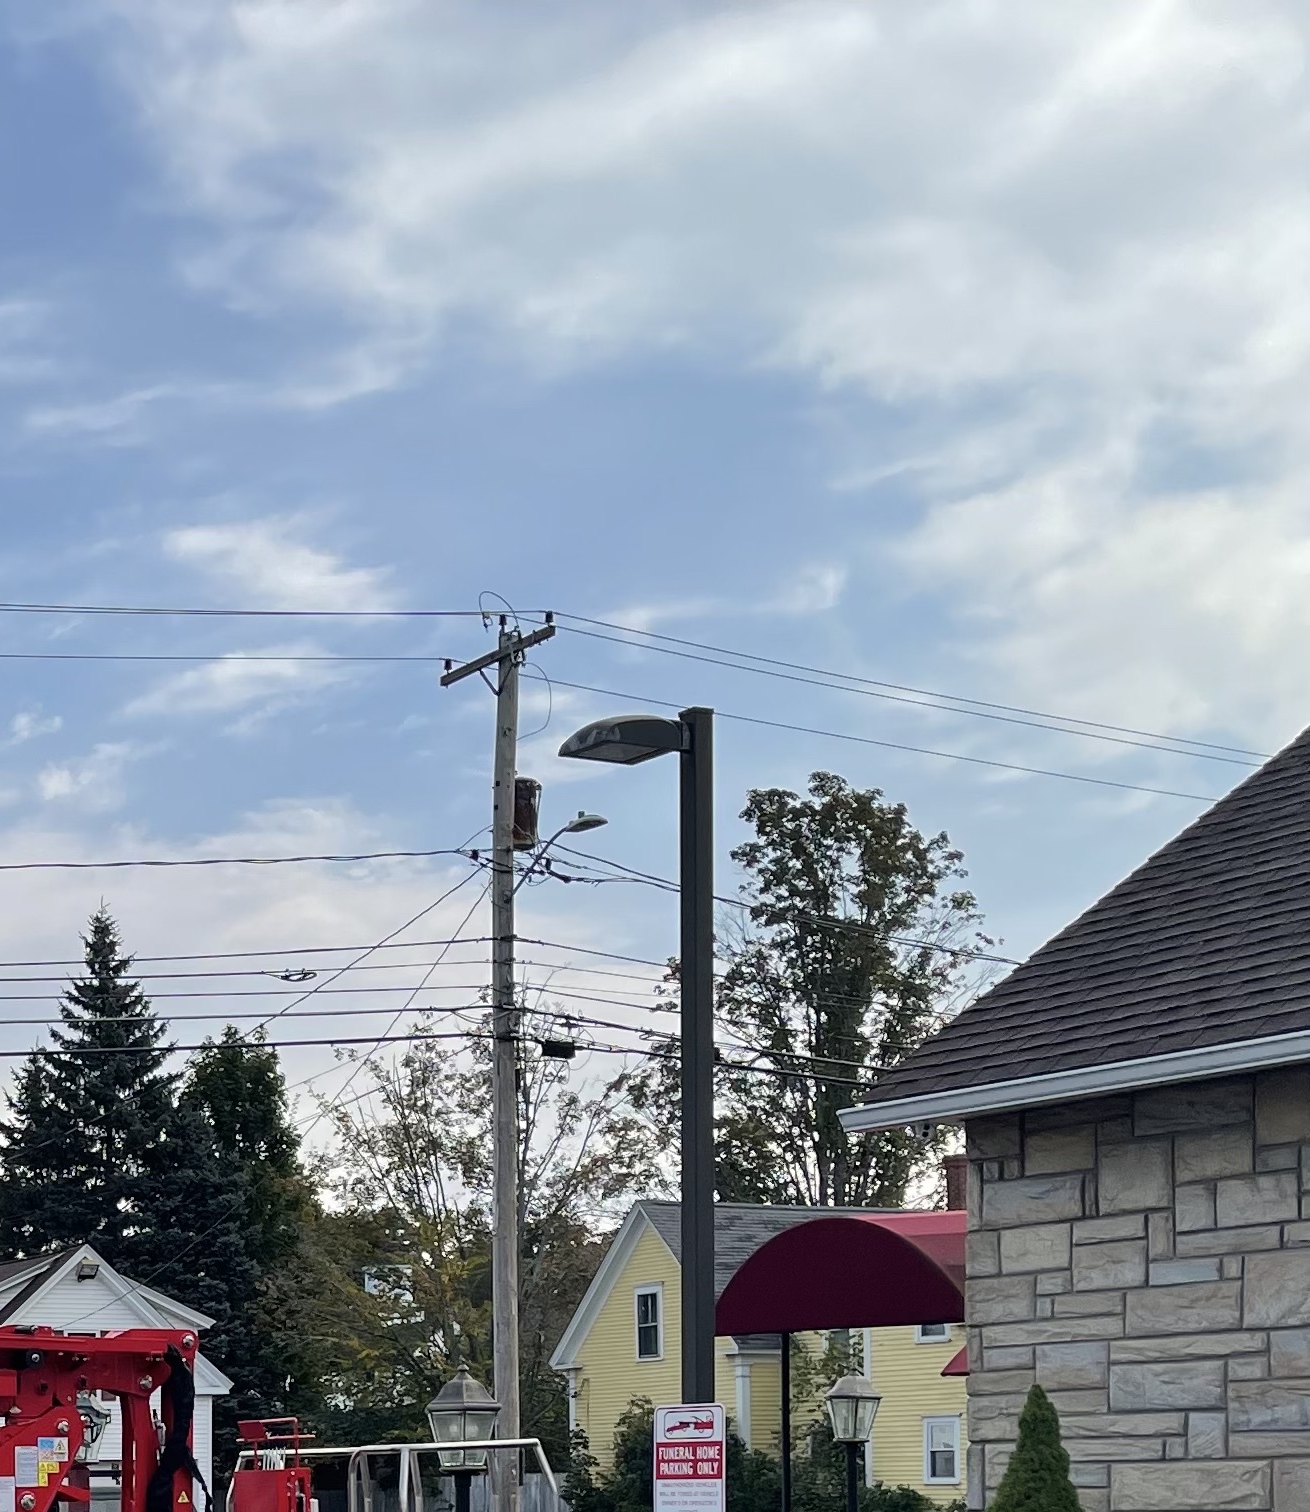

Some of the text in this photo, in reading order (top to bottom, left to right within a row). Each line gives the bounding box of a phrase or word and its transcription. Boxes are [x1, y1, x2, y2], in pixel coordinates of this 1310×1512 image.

[658, 1446, 720, 1460] FUNERAL HOME
[660, 1462, 719, 1475] PARKING ONLY
